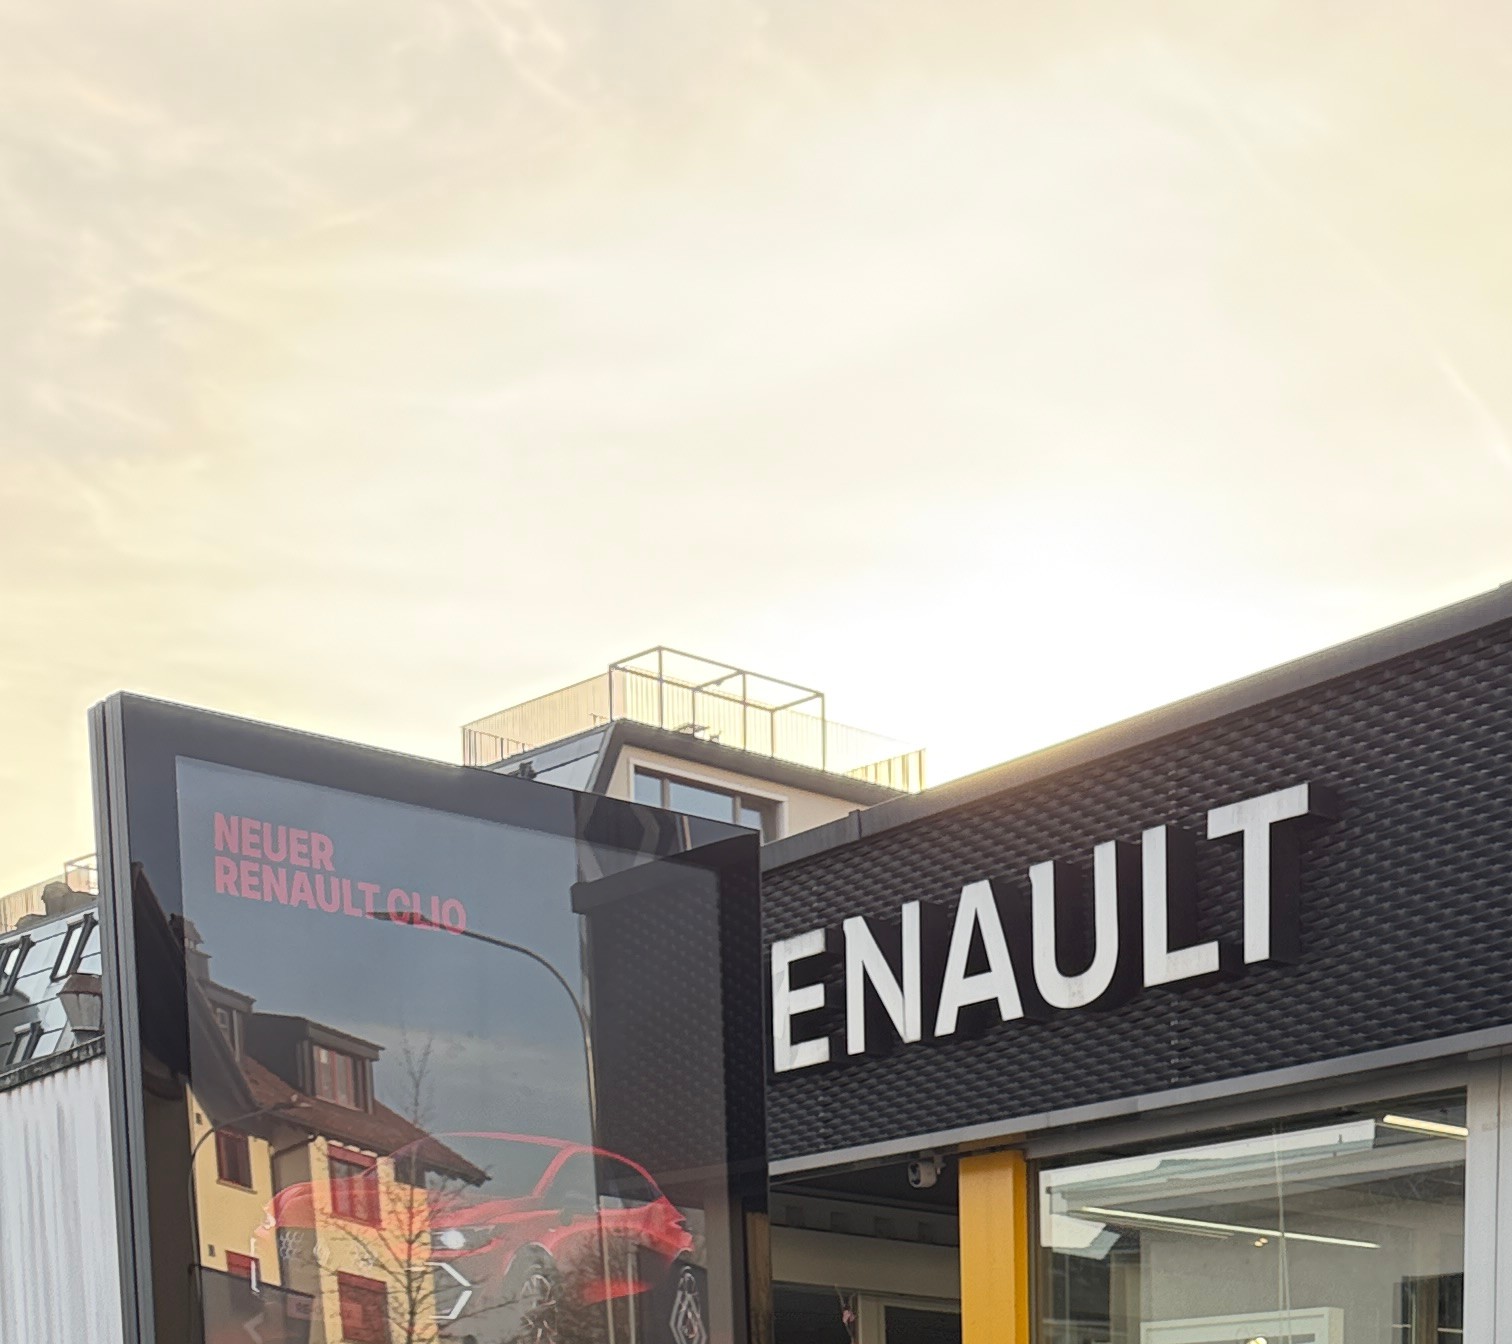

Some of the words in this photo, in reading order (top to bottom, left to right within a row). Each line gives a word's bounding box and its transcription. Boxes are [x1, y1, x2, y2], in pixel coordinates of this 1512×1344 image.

[213, 811, 335, 872] NEUER
[214, 855, 381, 920] RENAULT
[387, 887, 467, 936] CLIO
[771, 783, 1309, 1073] ENAULT
